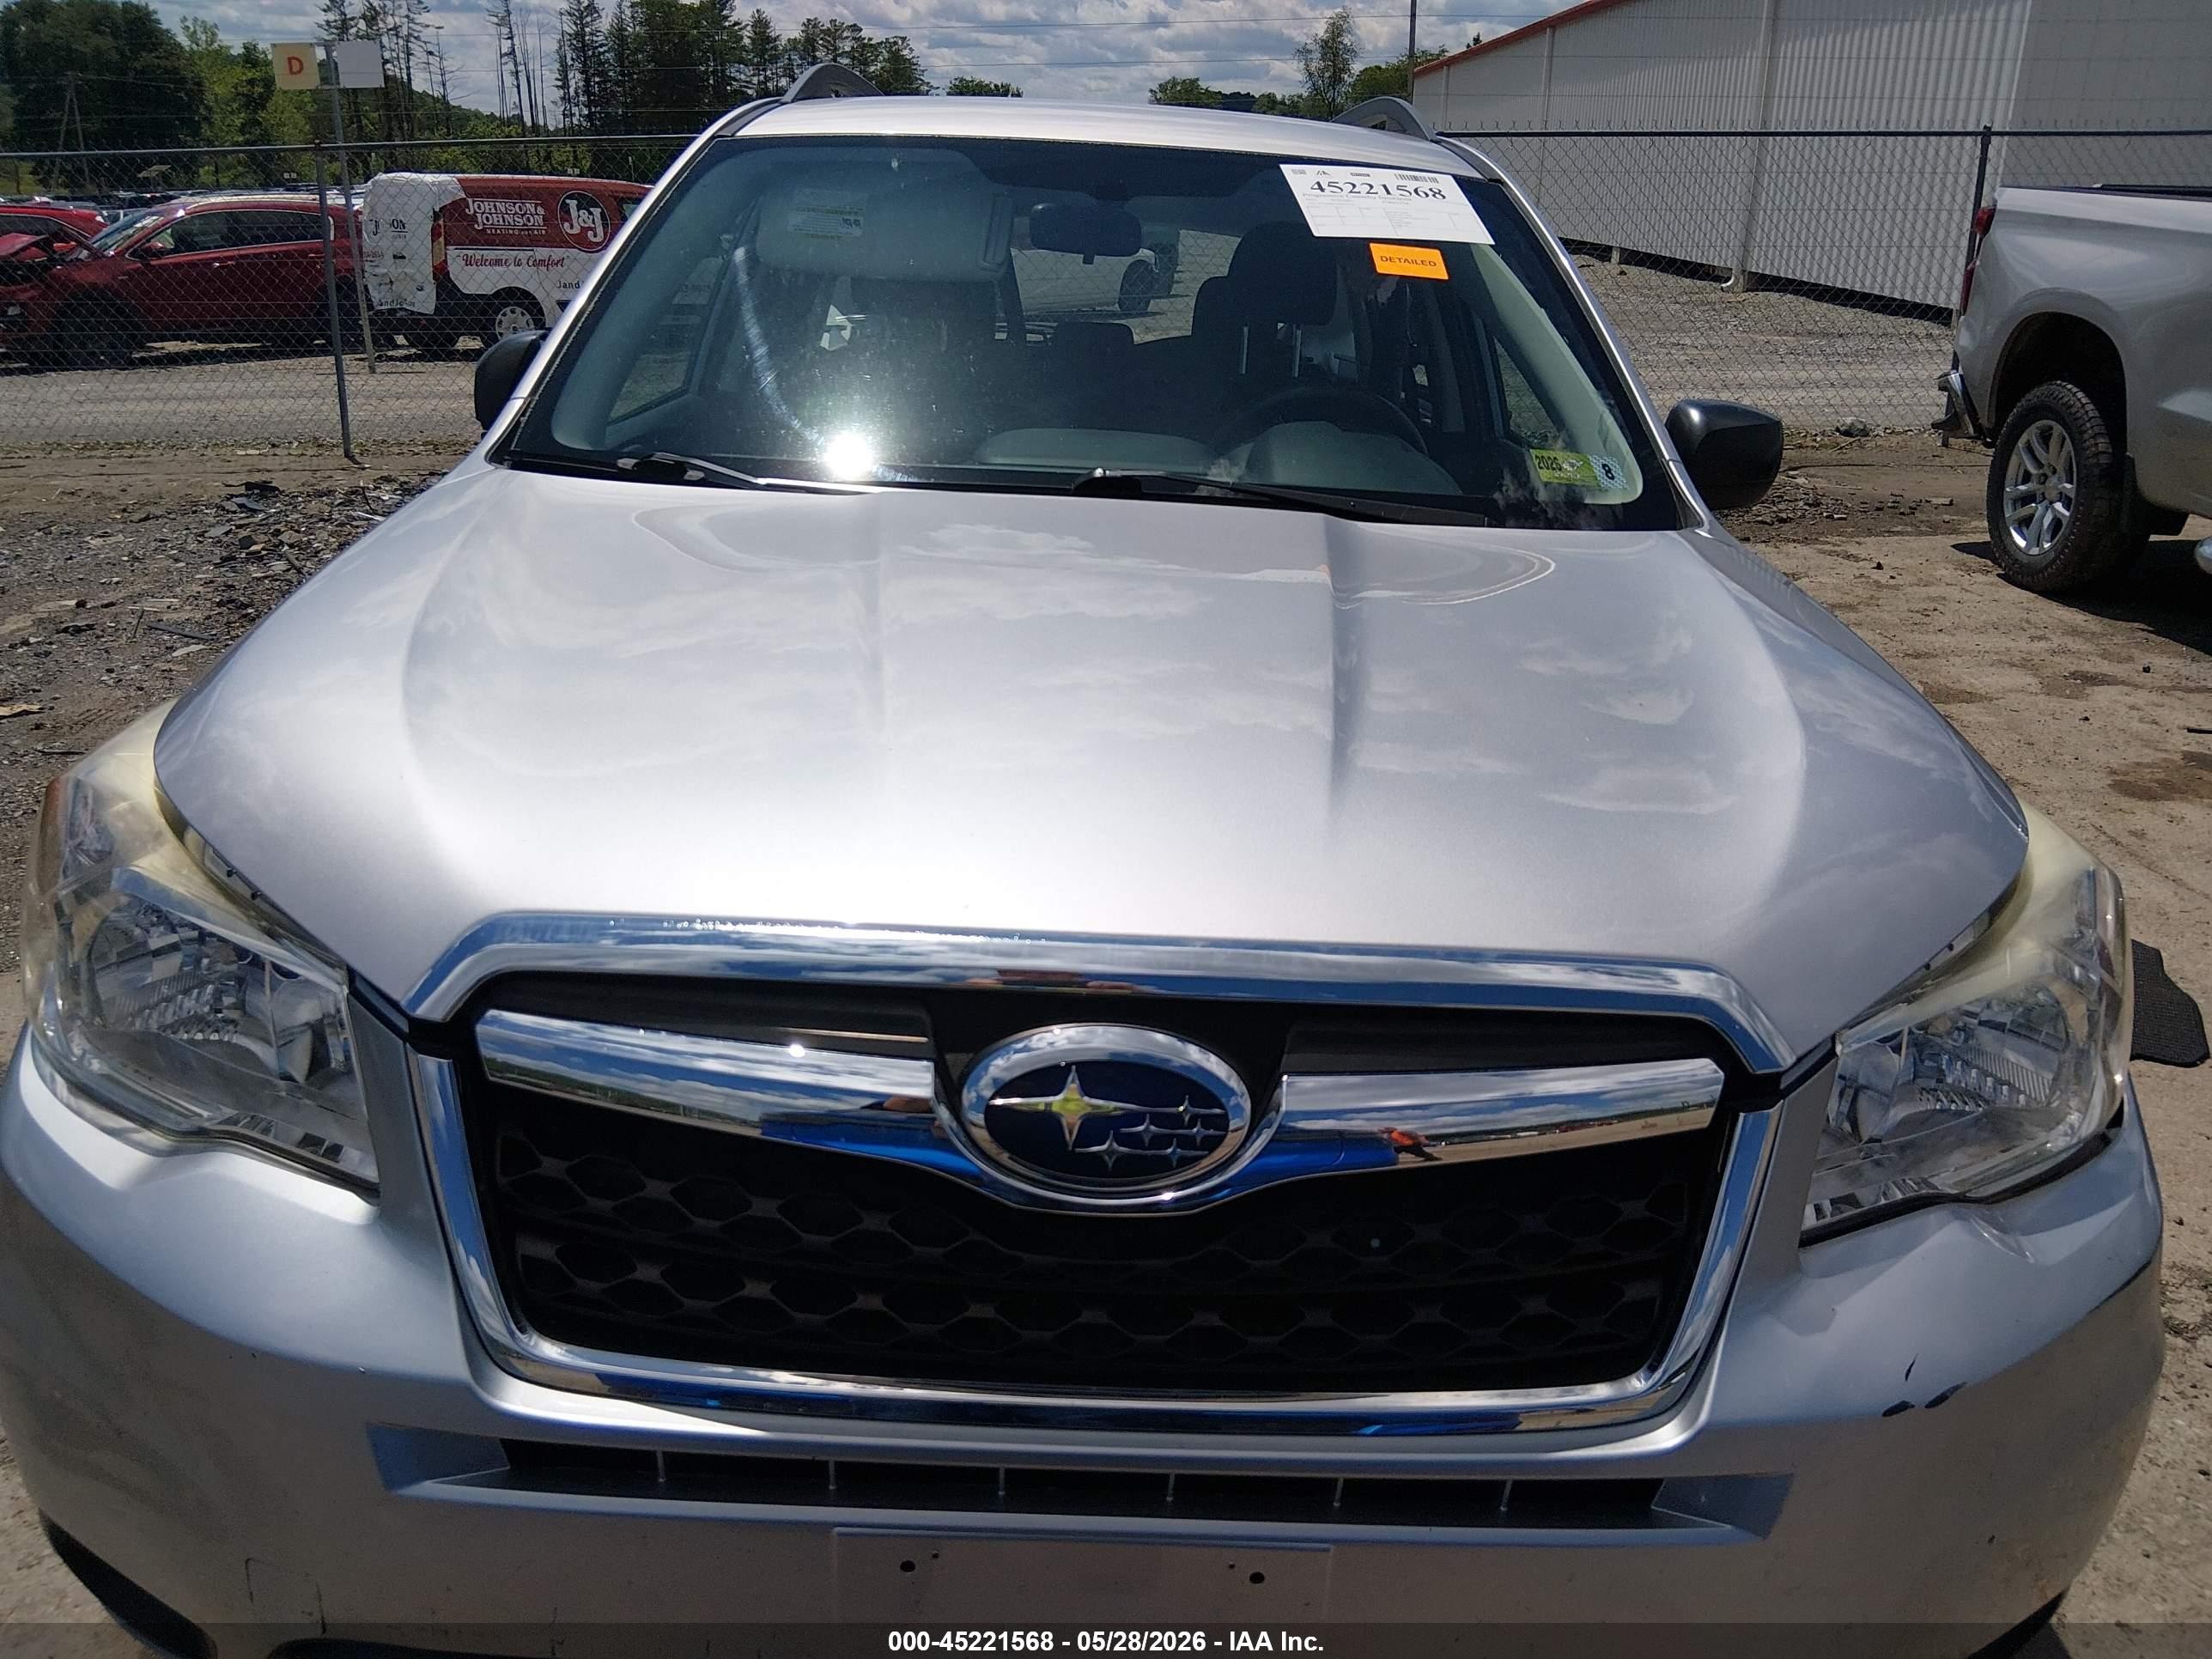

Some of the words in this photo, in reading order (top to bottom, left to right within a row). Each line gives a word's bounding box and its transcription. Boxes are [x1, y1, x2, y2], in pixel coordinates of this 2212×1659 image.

[288, 56, 304, 76] D
[1310, 180, 1447, 200] 45221568
[474, 214, 544, 229] JOHNSON
[563, 199, 605, 242] J&J
[1380, 255, 1437, 267] DETAILED
[1534, 454, 1562, 471] 2026
[1601, 463, 1615, 480] 8
